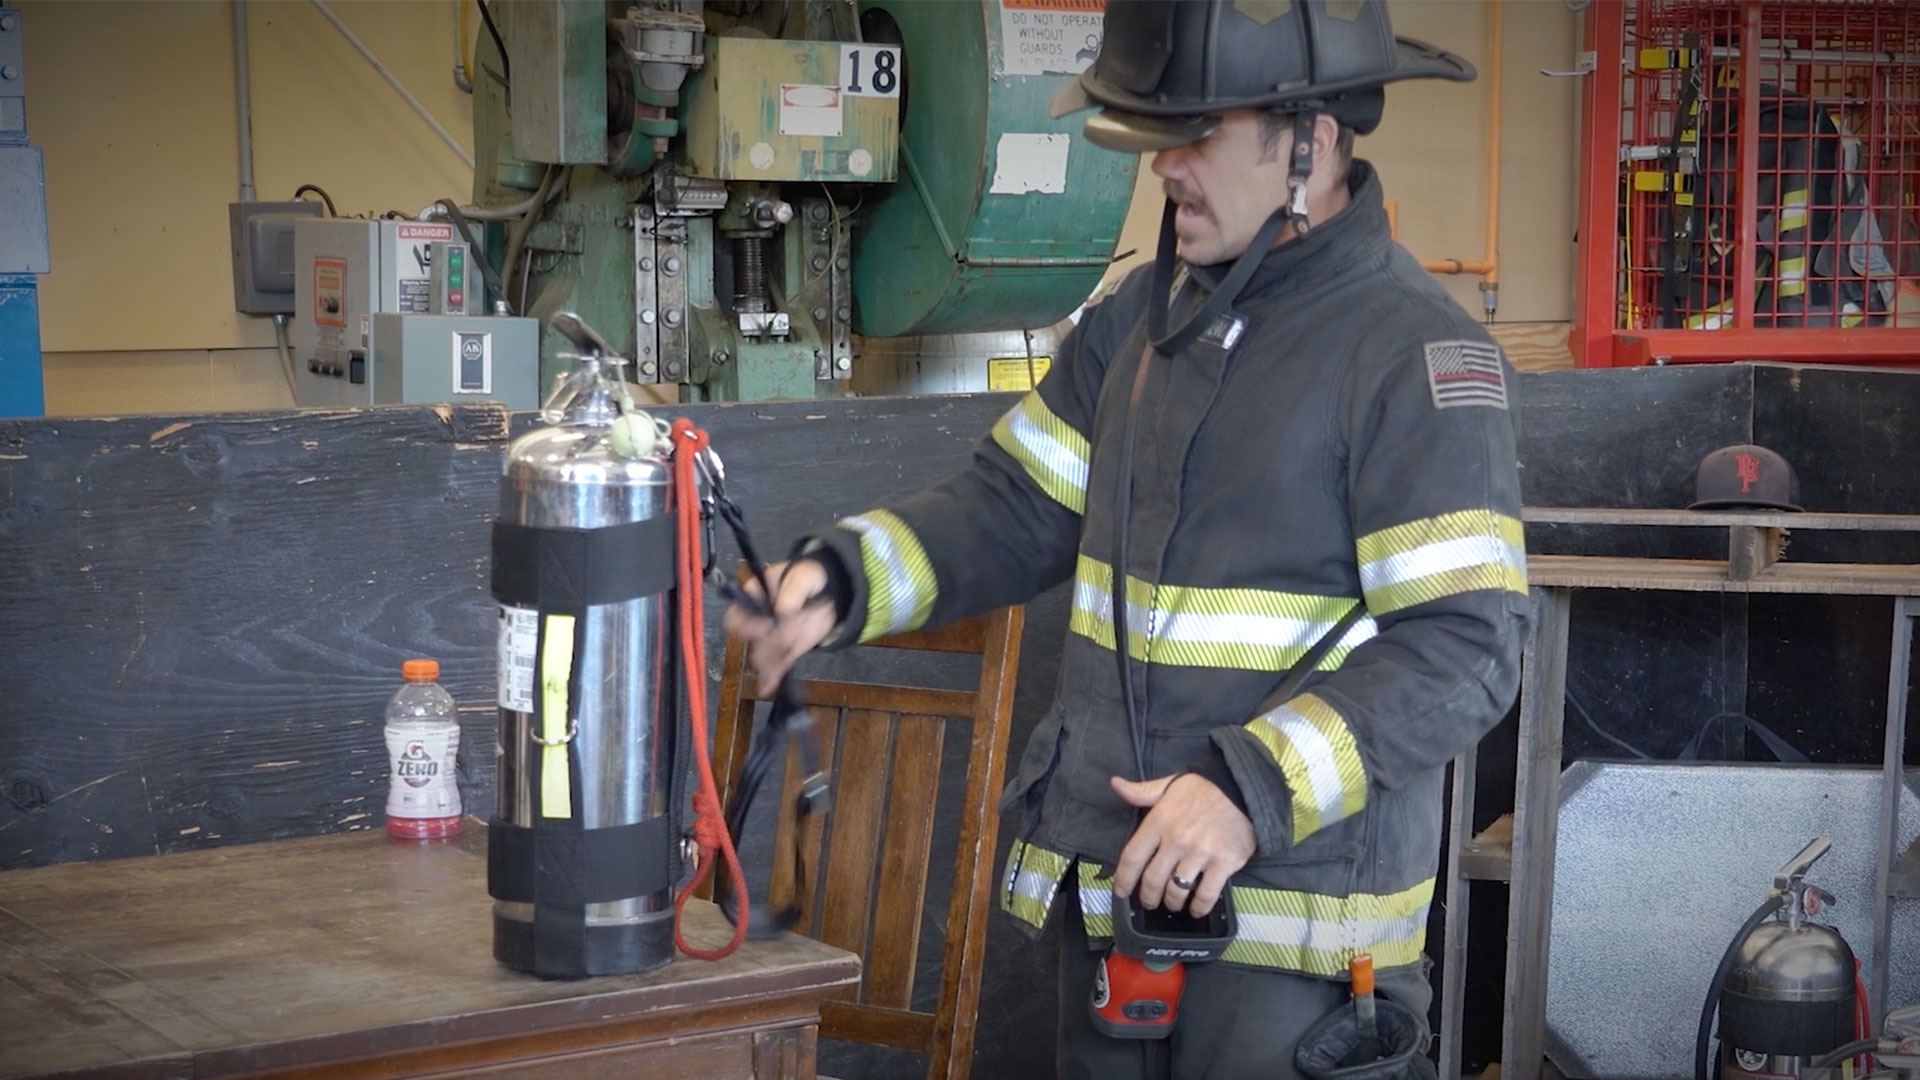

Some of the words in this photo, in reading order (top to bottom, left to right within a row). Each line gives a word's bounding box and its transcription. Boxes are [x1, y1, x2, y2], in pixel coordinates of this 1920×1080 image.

[1012, 12, 1027, 24] DO
[1034, 14, 1053, 25] NOT
[1062, 15, 1102, 27] OPERAT
[1019, 28, 1063, 40] WITHOUT
[1020, 42, 1063, 55] GUARDS
[848, 50, 896, 94] 18
[410, 227, 449, 237] DANGER
[397, 761, 438, 776] ZERO
